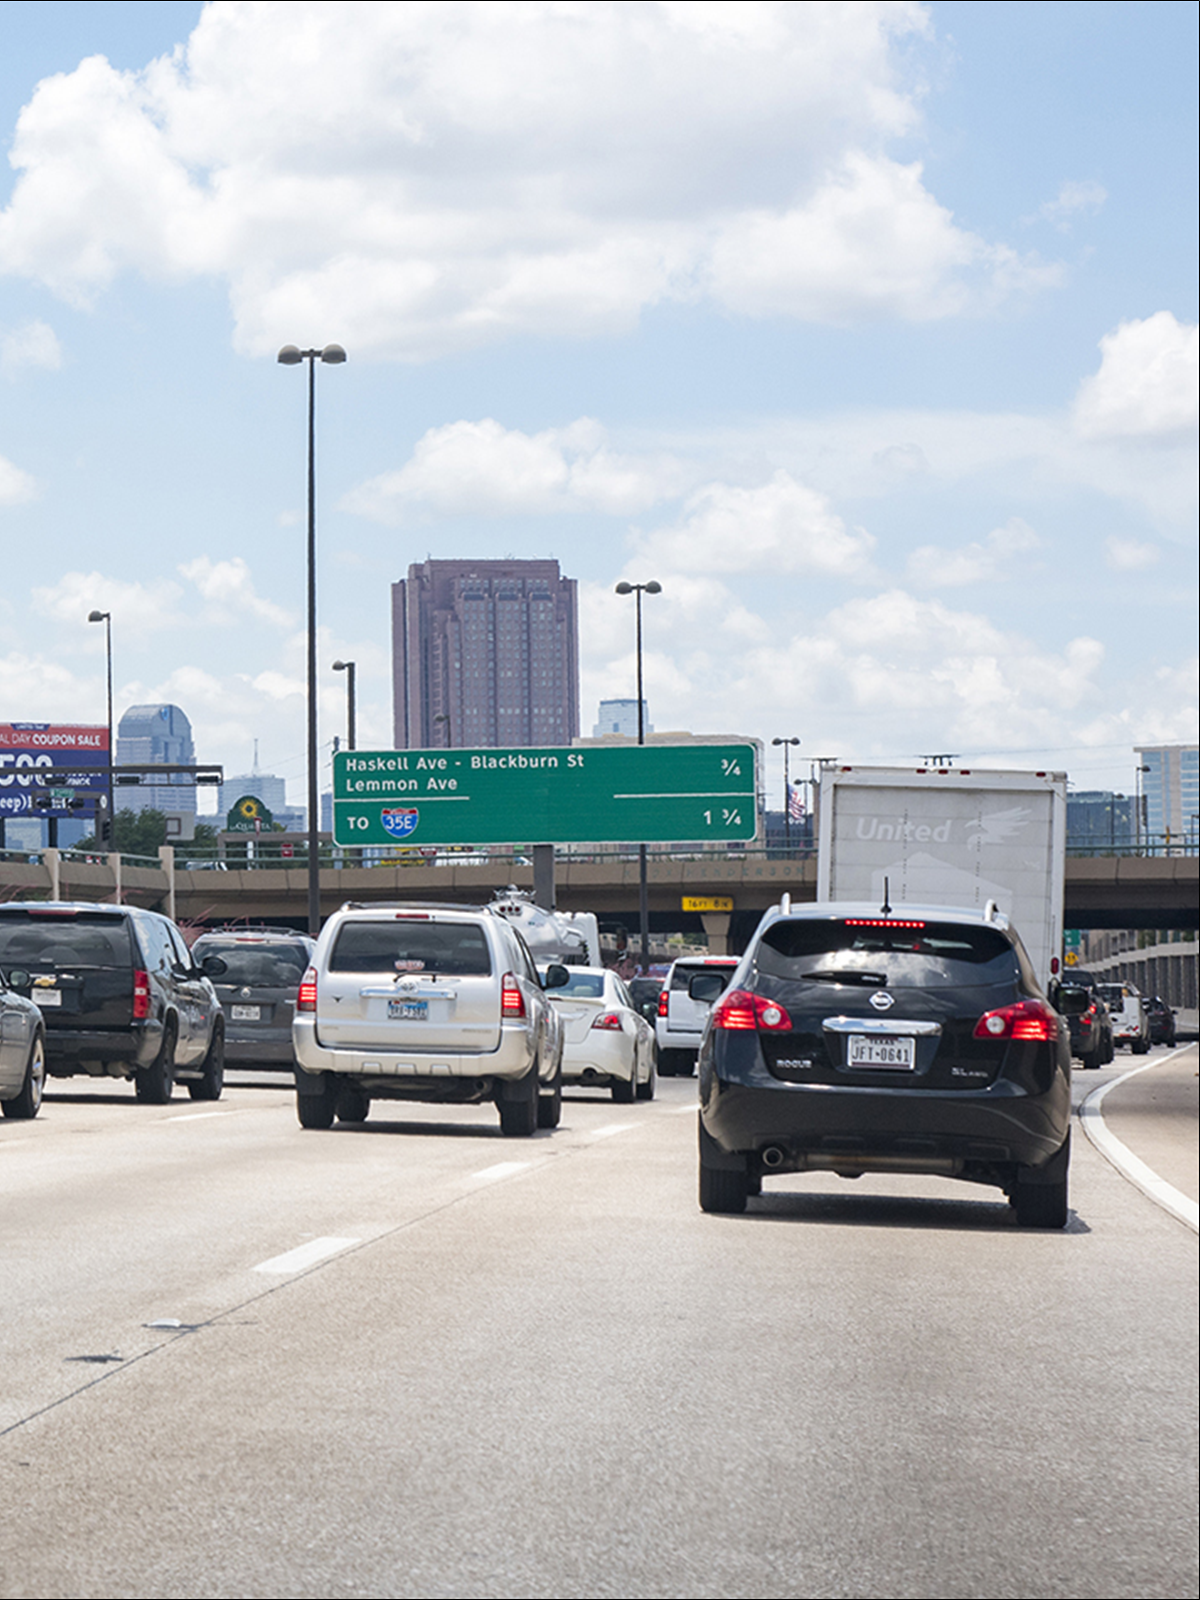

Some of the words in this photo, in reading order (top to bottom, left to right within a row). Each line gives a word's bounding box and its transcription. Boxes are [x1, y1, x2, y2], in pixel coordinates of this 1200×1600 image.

[11, 733, 31, 744] DAY
[32, 733, 76, 746] COUPON
[77, 735, 101, 747] SALE
[346, 757, 409, 771] Haskell
[416, 757, 448, 770] Ave
[471, 755, 558, 769] Blackburn
[567, 754, 585, 768] St
[346, 778, 418, 791] Lemmon
[426, 777, 458, 790] Ave
[347, 816, 369, 830] TO
[386, 815, 412, 830] 35E
[703, 810, 712, 825] 1
[856, 817, 952, 843] United
[624, 867, 672, 879] KOX
[870, 1038, 895, 1046] TEXAS
[776, 1059, 812, 1069] ROGUE
